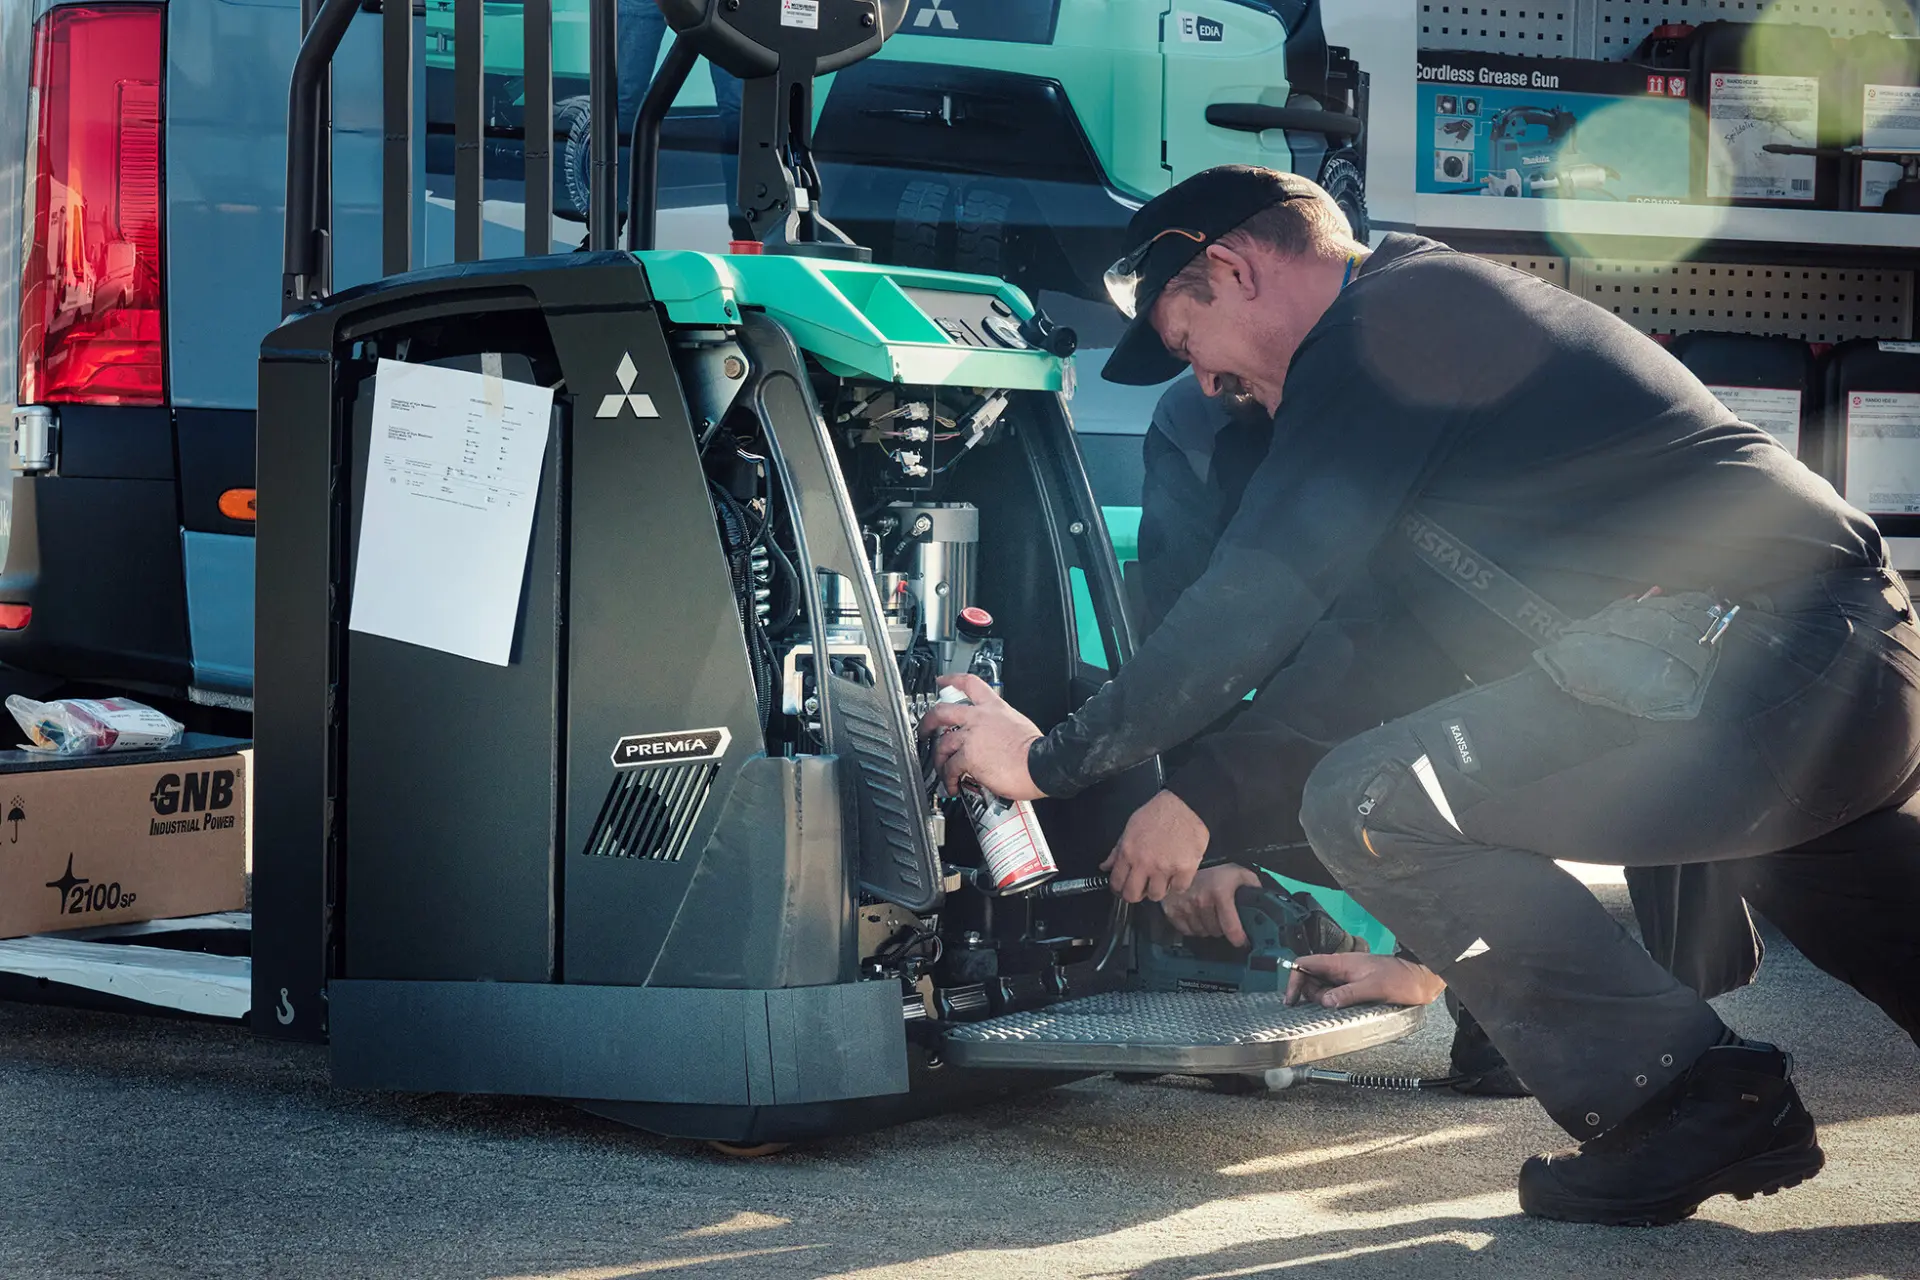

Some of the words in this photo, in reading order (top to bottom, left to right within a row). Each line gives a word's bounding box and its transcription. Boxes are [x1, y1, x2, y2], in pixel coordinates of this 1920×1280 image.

[1415, 62, 1475, 83] Cordless
[1478, 67, 1528, 86] Grease
[1531, 71, 1560, 89] Gun
[1450, 725, 1472, 764] KANSAS
[150, 769, 235, 816] GNB
